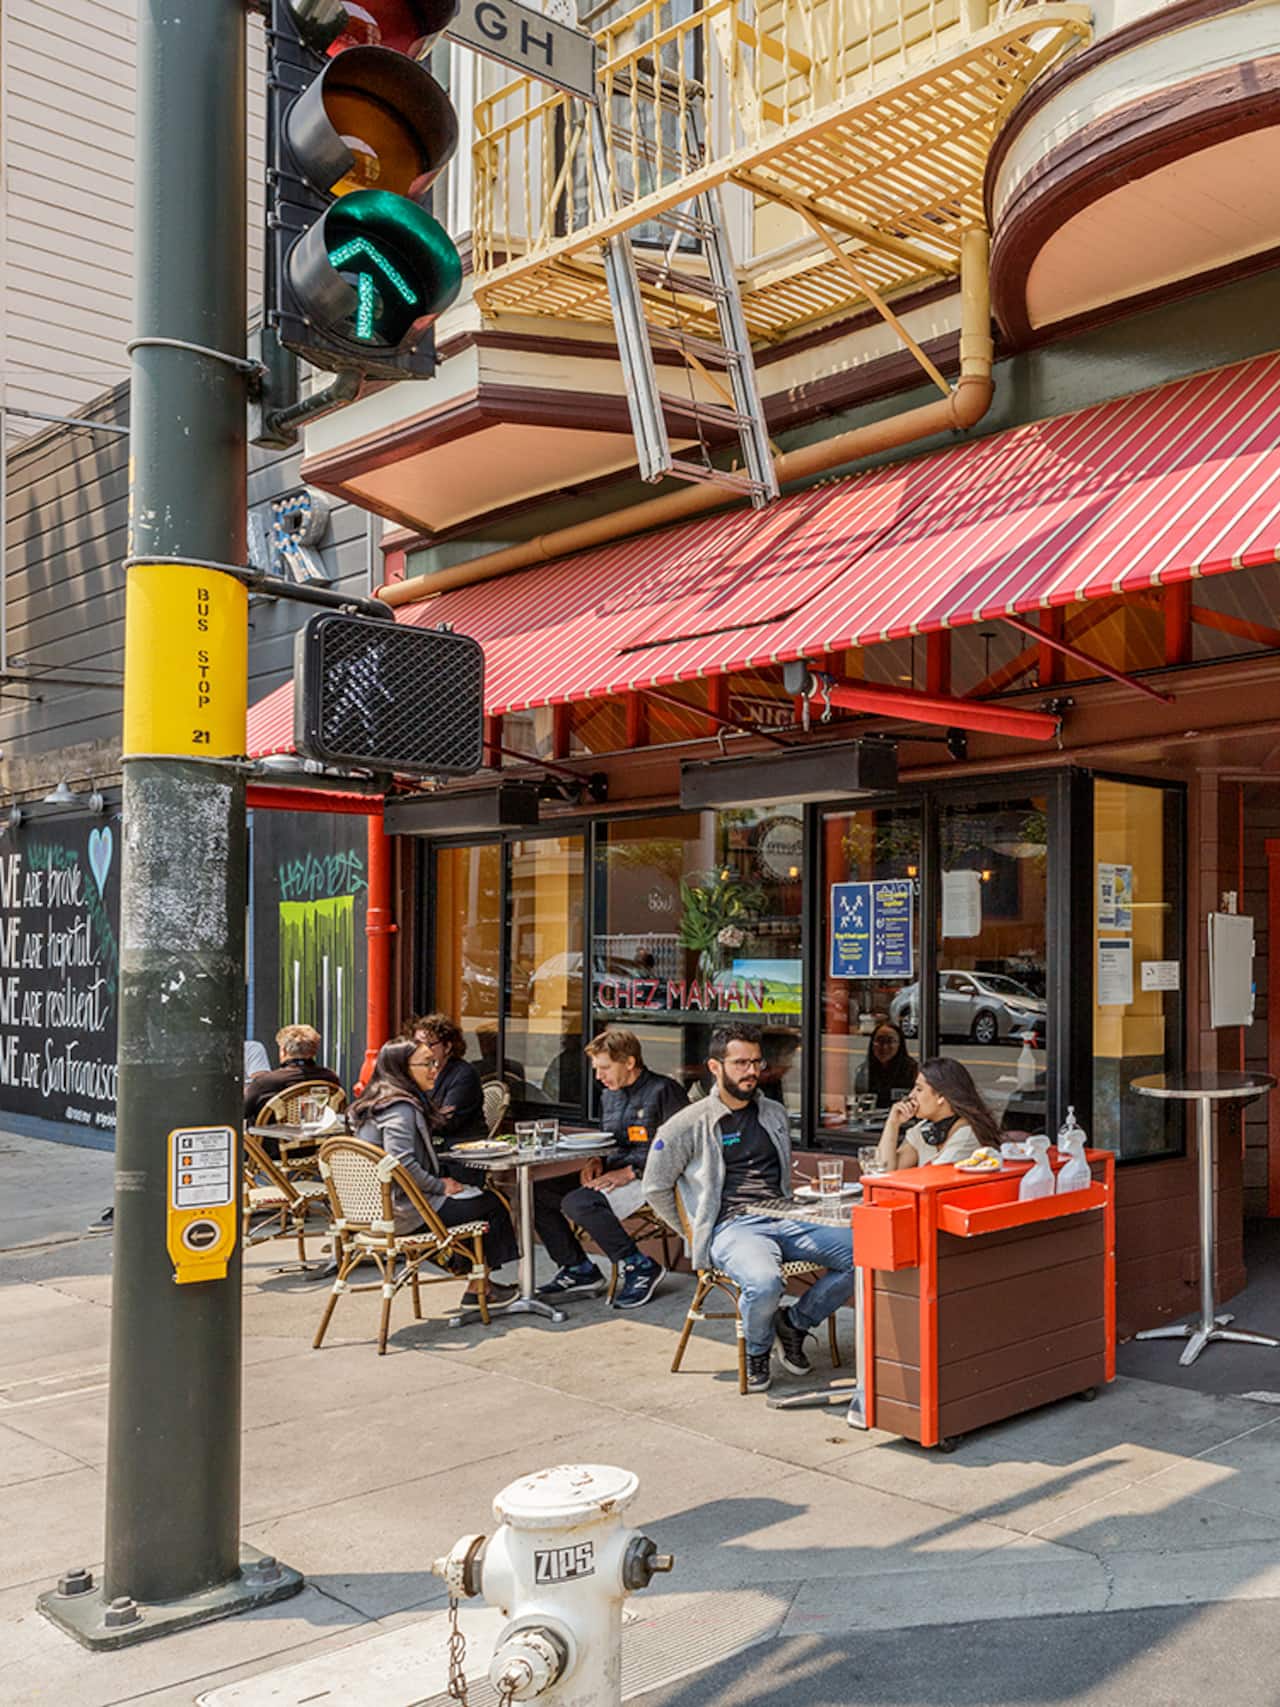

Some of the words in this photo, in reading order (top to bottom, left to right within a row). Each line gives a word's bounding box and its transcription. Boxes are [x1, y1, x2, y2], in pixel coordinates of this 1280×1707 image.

[474, 2, 553, 66] GH
[197, 588, 210, 632] BUS
[197, 650, 210, 708] STOP
[192, 729, 210, 744] 21
[23, 871, 43, 908] ARE
[22, 932, 43, 969] ARE
[21, 991, 43, 1027] ARE
[598, 977, 660, 1010] CHEZ
[666, 977, 766, 1012] MAMAN
[21, 1051, 41, 1089] ARE
[536, 1543, 595, 1583] ZIPS
